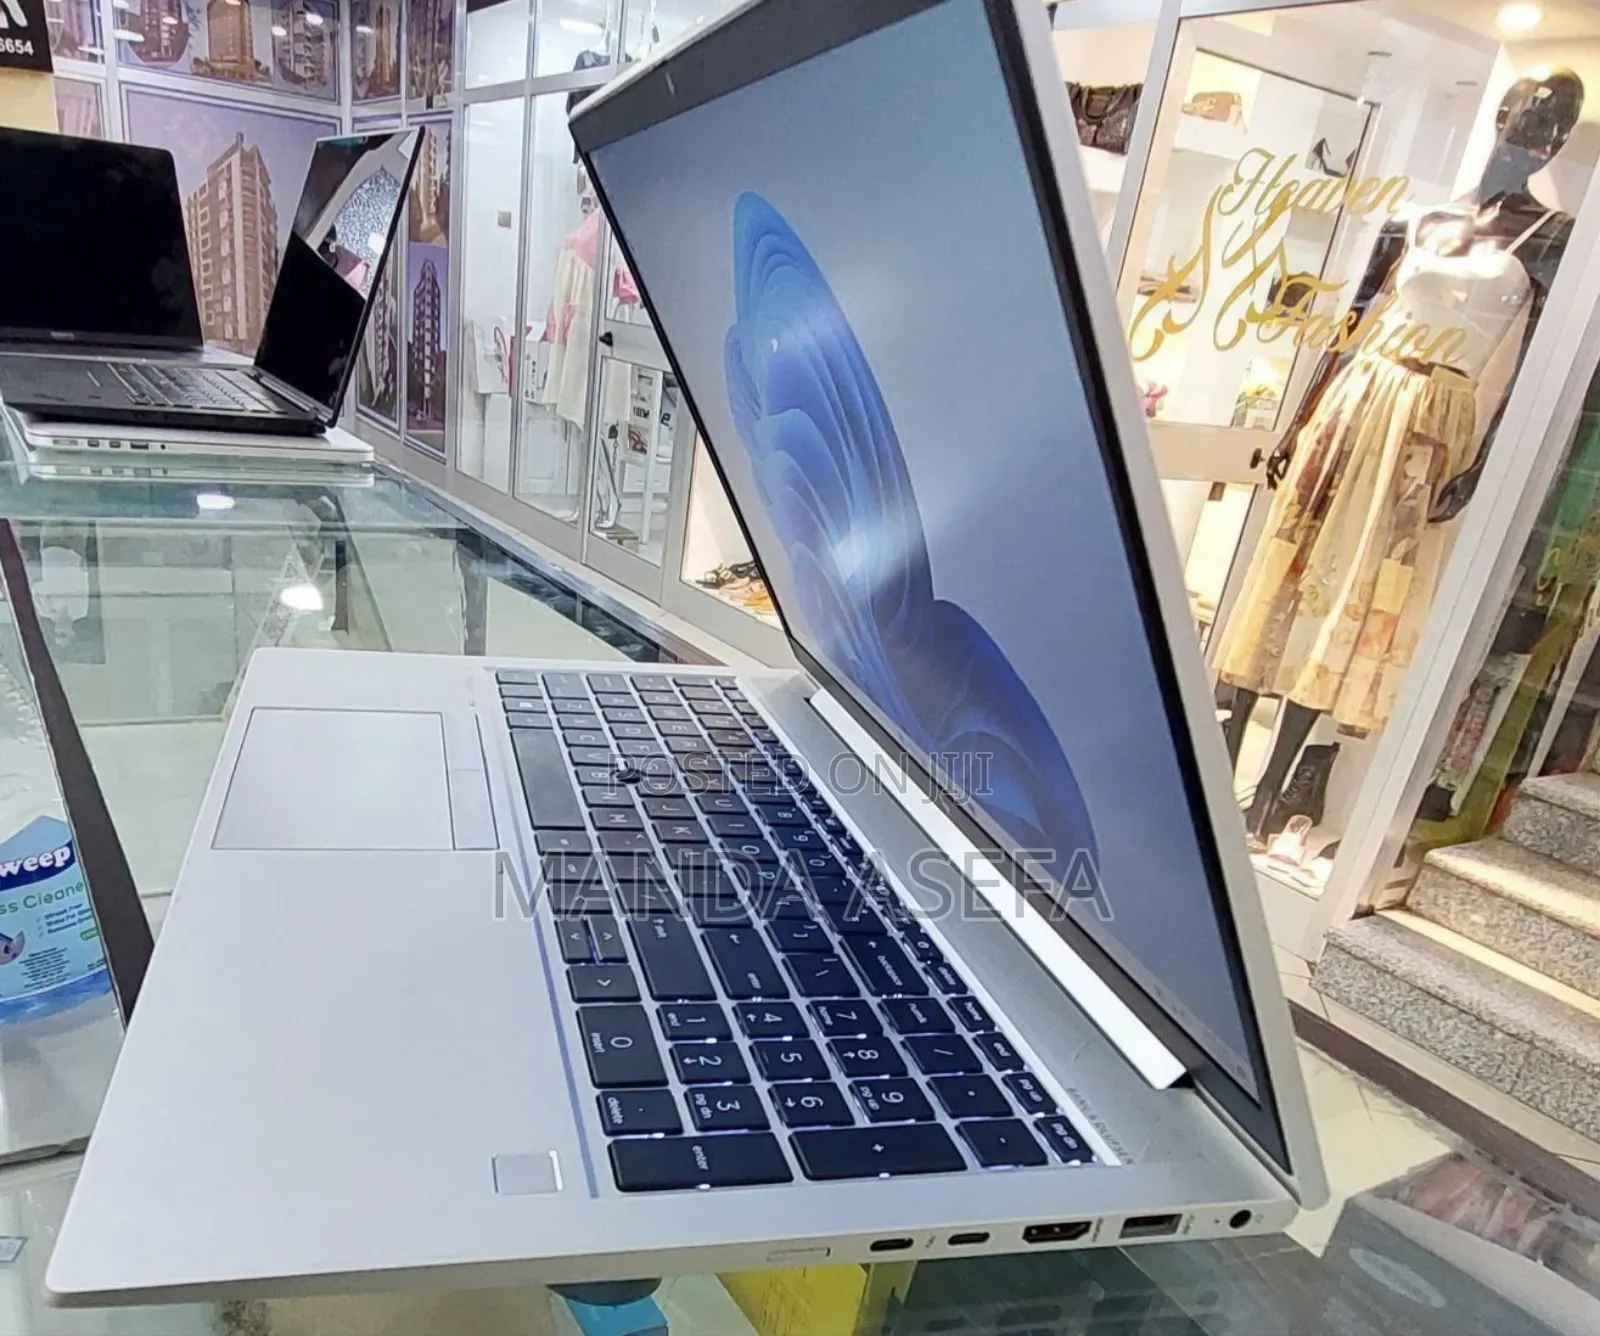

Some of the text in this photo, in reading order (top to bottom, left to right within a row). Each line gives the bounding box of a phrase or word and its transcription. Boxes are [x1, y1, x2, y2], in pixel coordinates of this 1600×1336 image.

[1256, 276, 1468, 363] Fashion
[763, 1012, 783, 1024] 4
[836, 1011, 858, 1021] 7
[780, 1053, 803, 1063] 5
[857, 1049, 879, 1060] 8
[699, 1055, 722, 1067] 2
[801, 1096, 824, 1108] 6
[881, 1091, 904, 1104] 9
[717, 1100, 741, 1112] 3
[692, 1145, 709, 1171] enter
